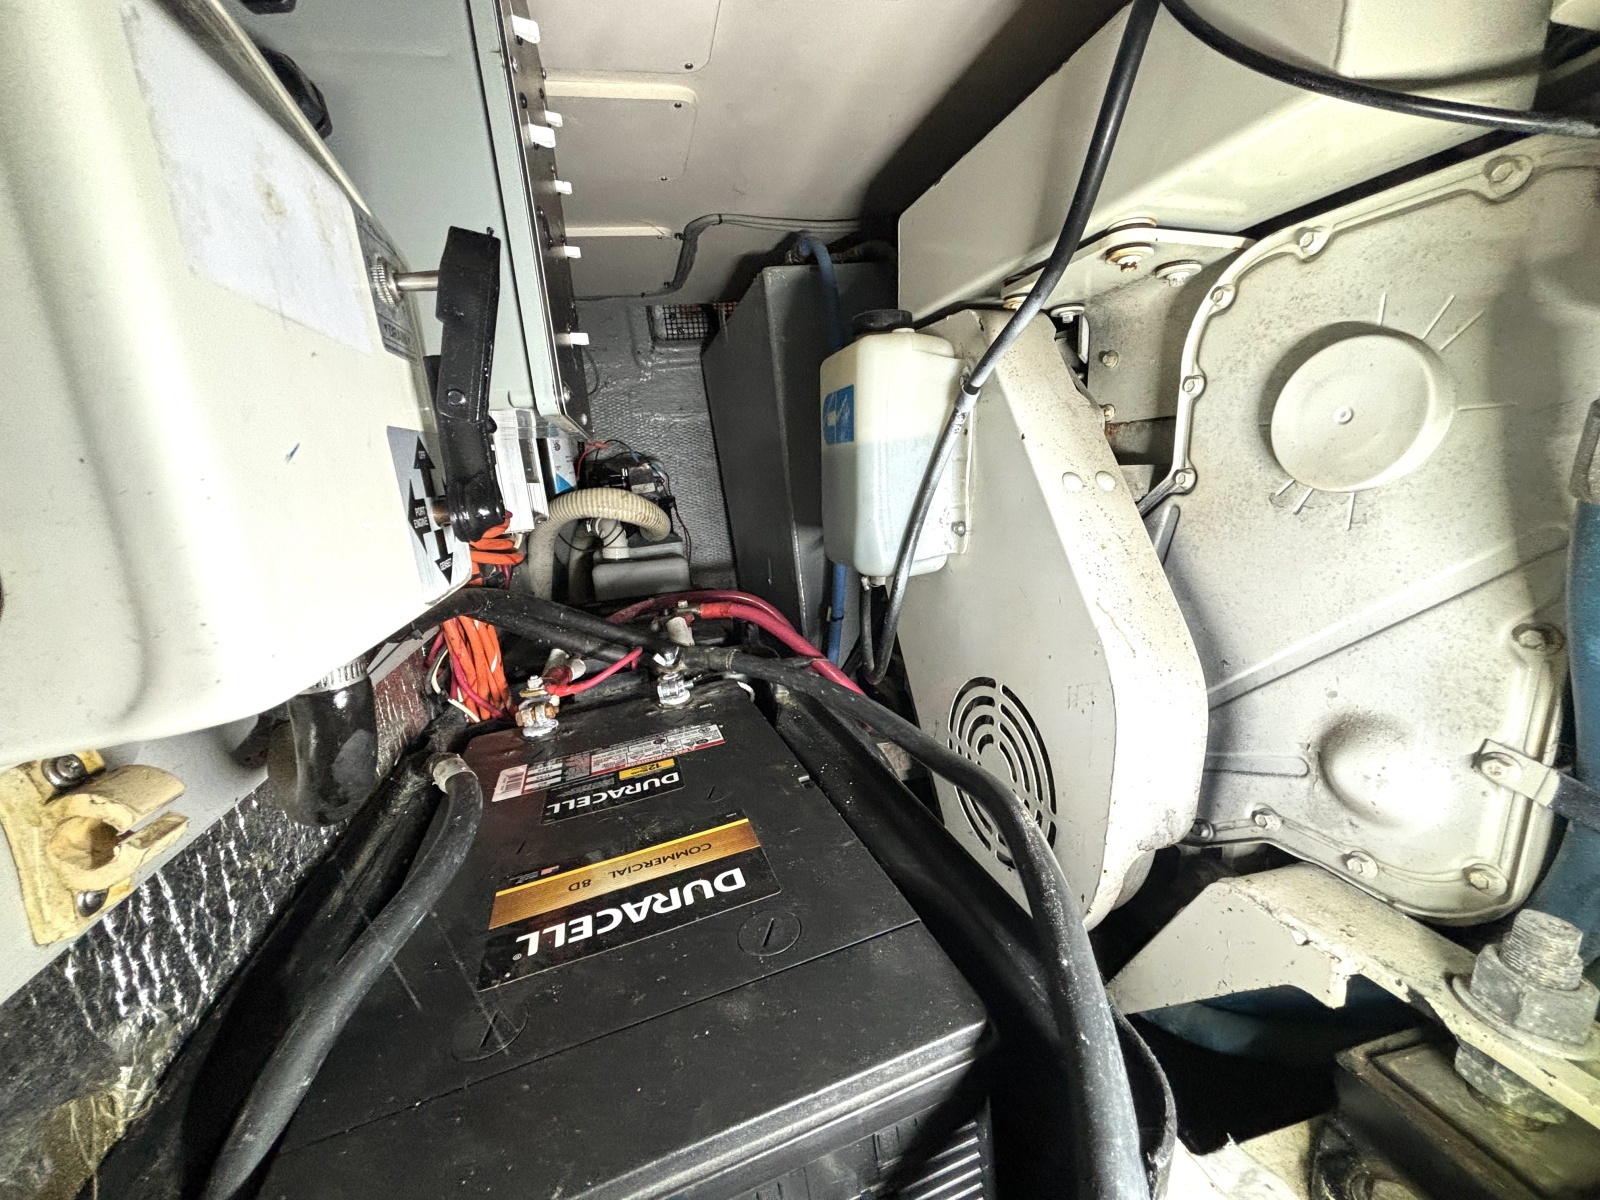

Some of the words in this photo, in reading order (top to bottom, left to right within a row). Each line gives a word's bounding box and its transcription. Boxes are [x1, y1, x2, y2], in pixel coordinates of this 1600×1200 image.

[413, 516, 429, 529] ENGINE
[414, 505, 426, 517] PORT
[547, 771, 680, 814] DURACELL
[607, 842, 712, 879] COMMERCIAL
[568, 878, 592, 892] 8D
[515, 867, 747, 957] DURACELL
